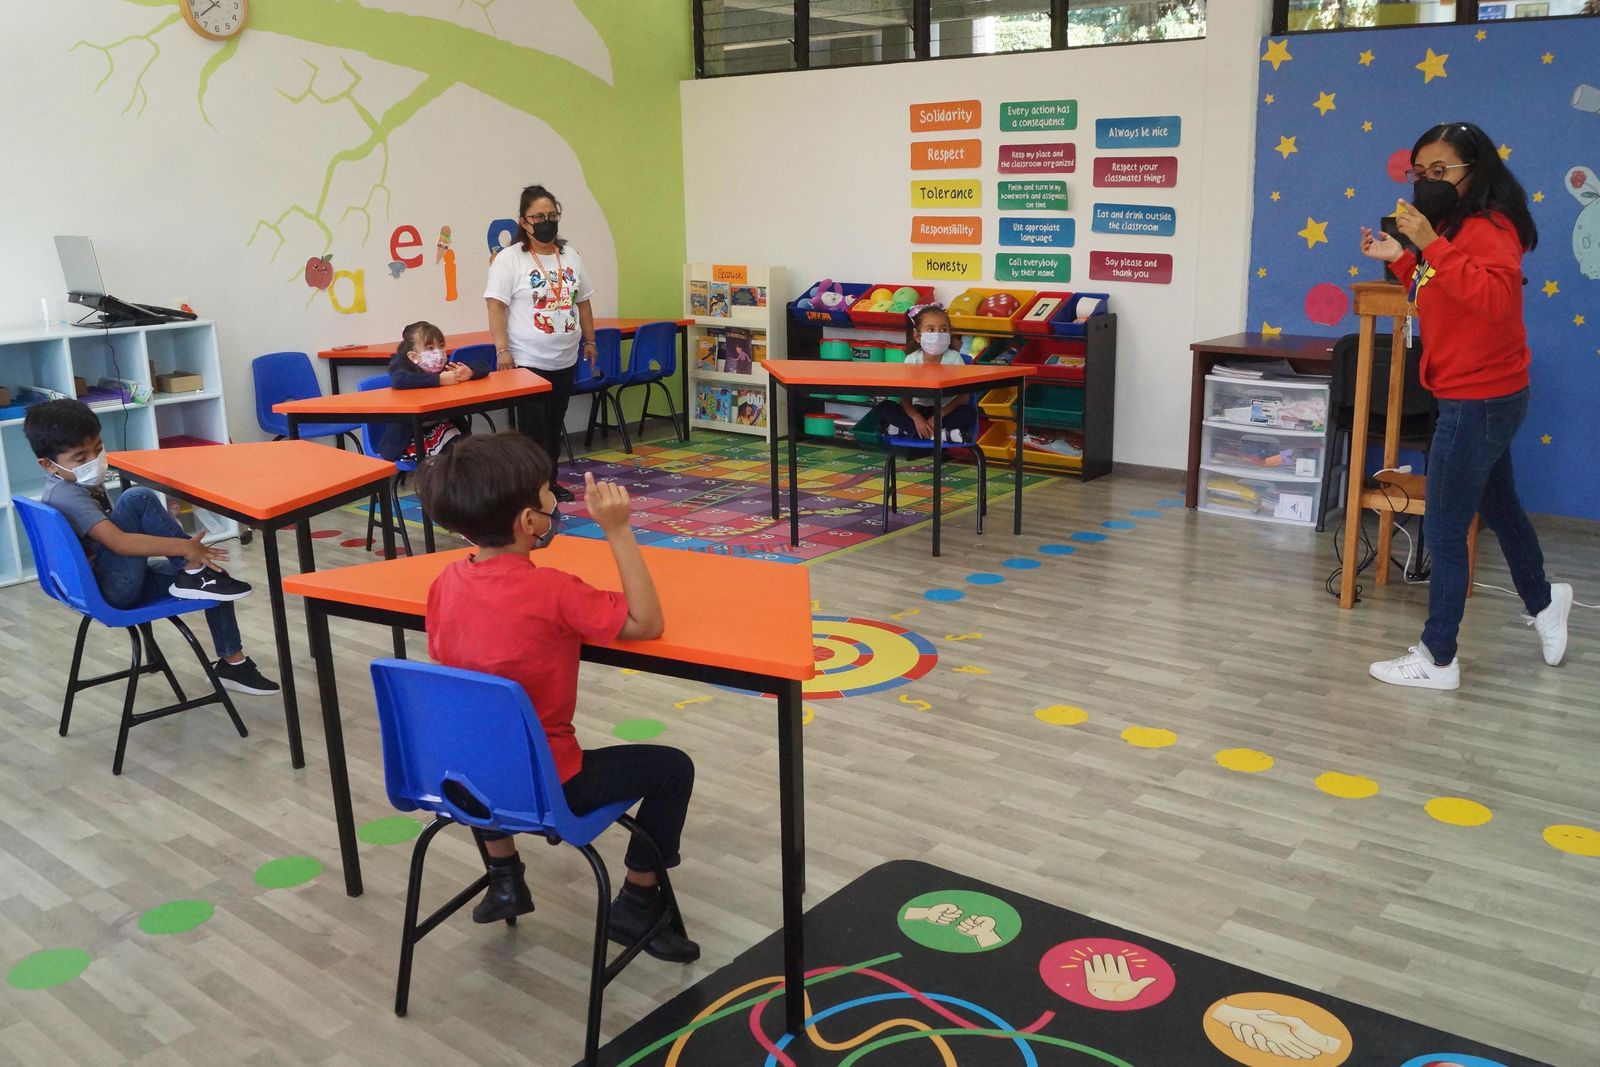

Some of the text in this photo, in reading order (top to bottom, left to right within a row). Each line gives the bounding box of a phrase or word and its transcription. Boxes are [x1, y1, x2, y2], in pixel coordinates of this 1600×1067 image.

[233, 2, 239, 10] 3
[194, 11, 200, 19] 8
[214, 25, 220, 33] 6
[1008, 104, 1070, 117] Every action has
[919, 108, 973, 124] Solidarity
[1019, 118, 1065, 128] consequence
[1108, 126, 1169, 139] Always be nice
[927, 147, 965, 164] Respect
[1012, 151, 1025, 159] Keep
[1036, 150, 1051, 159] place
[1052, 150, 1064, 158] and
[1011, 160, 1042, 168] classroom
[1043, 159, 1074, 169] organized
[1112, 163, 1159, 173] Respect your
[1104, 173, 1166, 184] classmates things
[920, 187, 974, 200] Tolerance
[1097, 209, 1172, 221] Eat and drink outside
[920, 223, 974, 236] Responsibility
[1013, 223, 1024, 231] Use
[1108, 221, 1159, 231] the classroom
[1020, 233, 1053, 243] language
[926, 258, 968, 275] Honesty
[1008, 258, 1058, 269] Call everybody
[1105, 257, 1157, 268] Say please and
[1012, 268, 1019, 278] by
[1021, 269, 1036, 277] their
[1112, 269, 1149, 279] thank you
